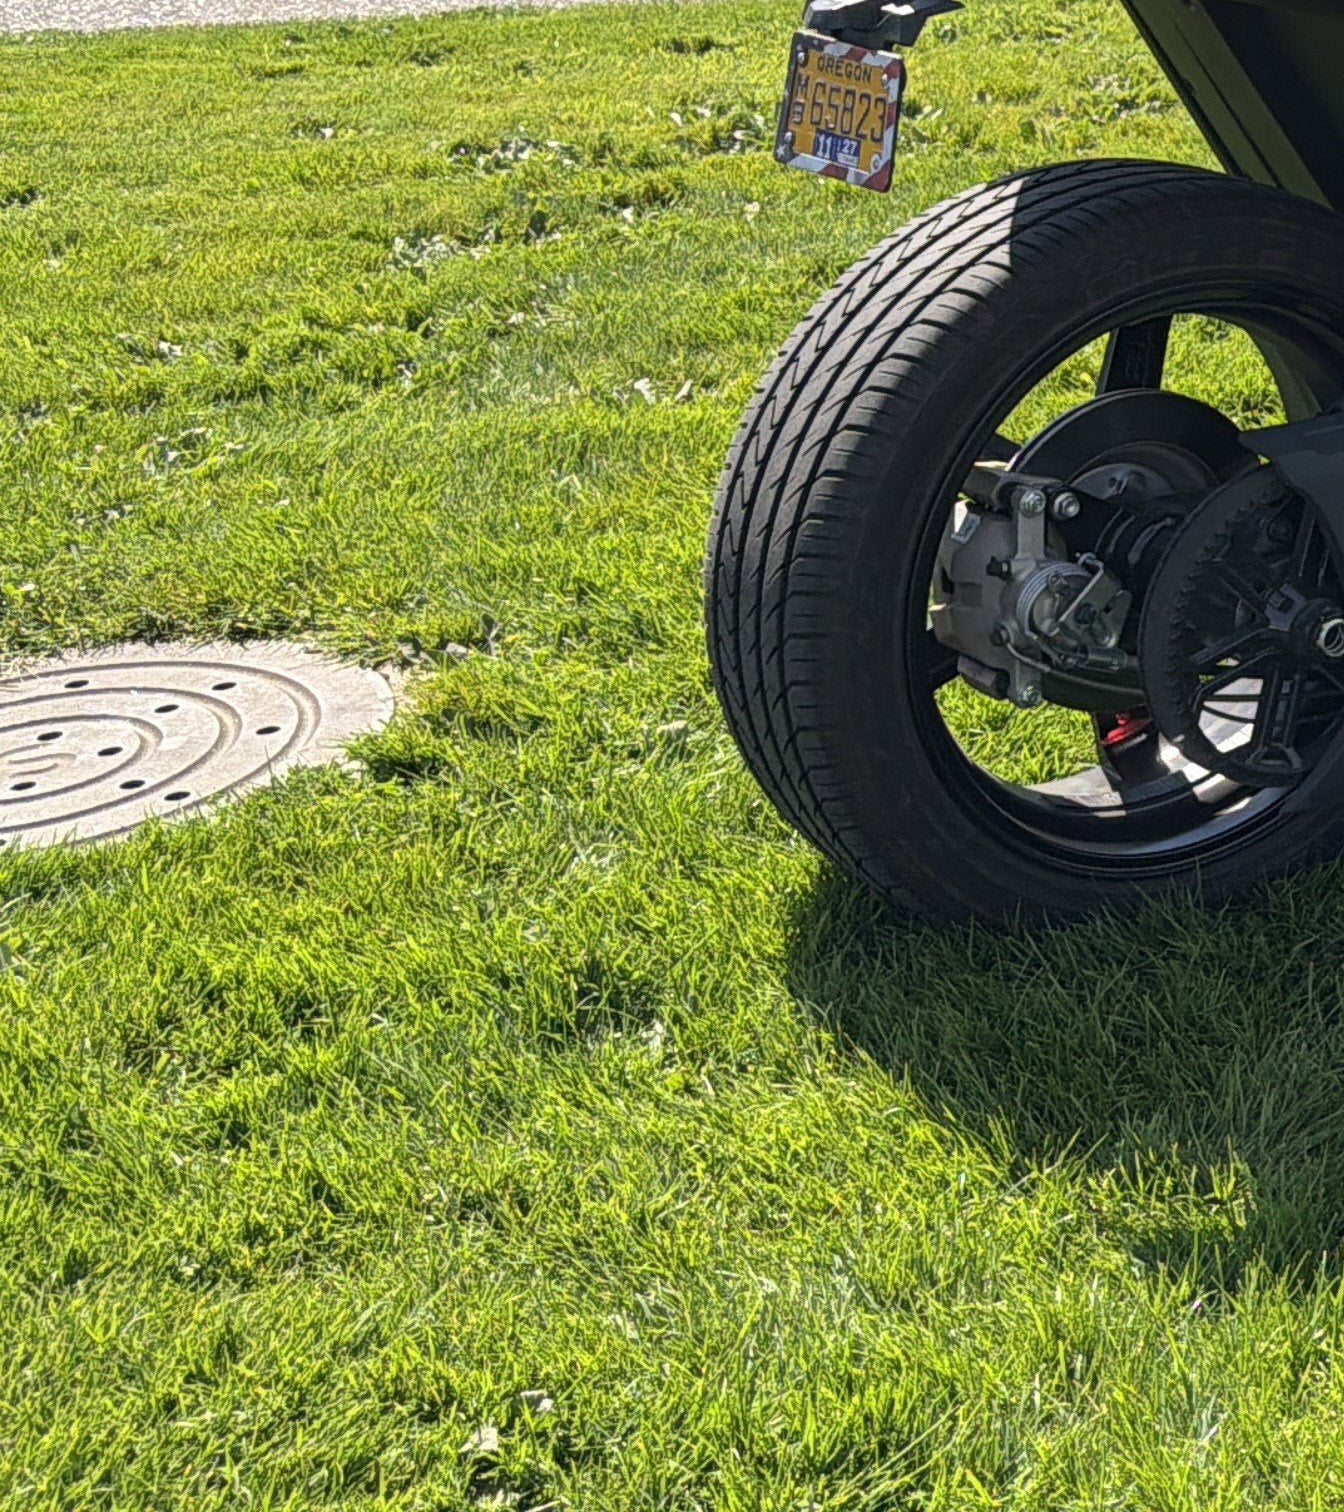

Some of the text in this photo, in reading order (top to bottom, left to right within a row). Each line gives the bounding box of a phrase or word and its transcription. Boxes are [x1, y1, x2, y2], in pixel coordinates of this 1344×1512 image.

[816, 55, 873, 84] OREGON
[810, 82, 887, 143] 65823
[817, 133, 833, 159] 11
[842, 139, 858, 155] 27
